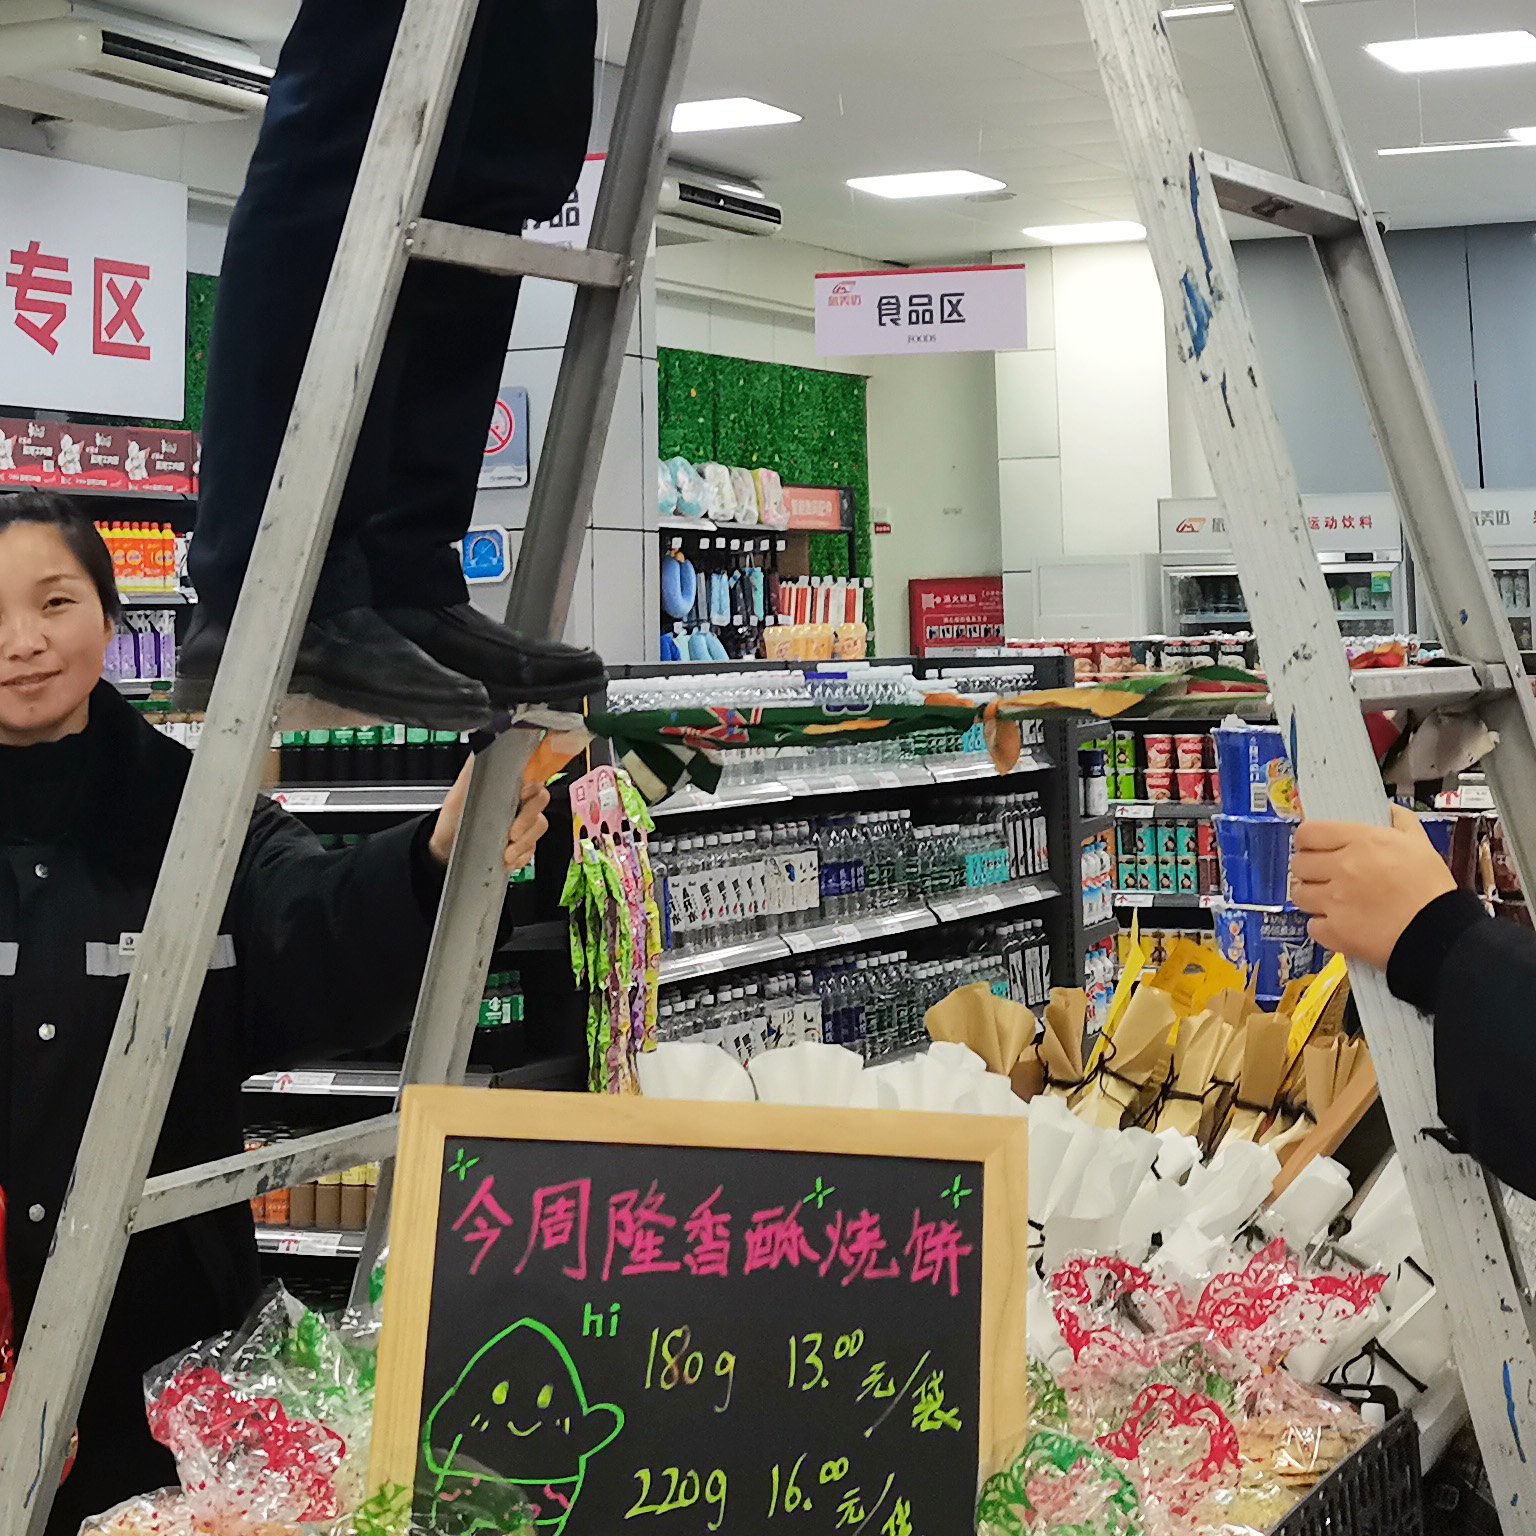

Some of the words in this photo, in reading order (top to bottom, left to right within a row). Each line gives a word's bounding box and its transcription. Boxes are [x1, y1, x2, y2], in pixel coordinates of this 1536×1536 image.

[877, 293, 966, 326] 食品区
[452, 1174, 974, 1297] 今周隆香酥烧饼
[581, 1302, 620, 1338] hi
[644, 1326, 737, 1412] 180g
[624, 1467, 727, 1530] 220g
